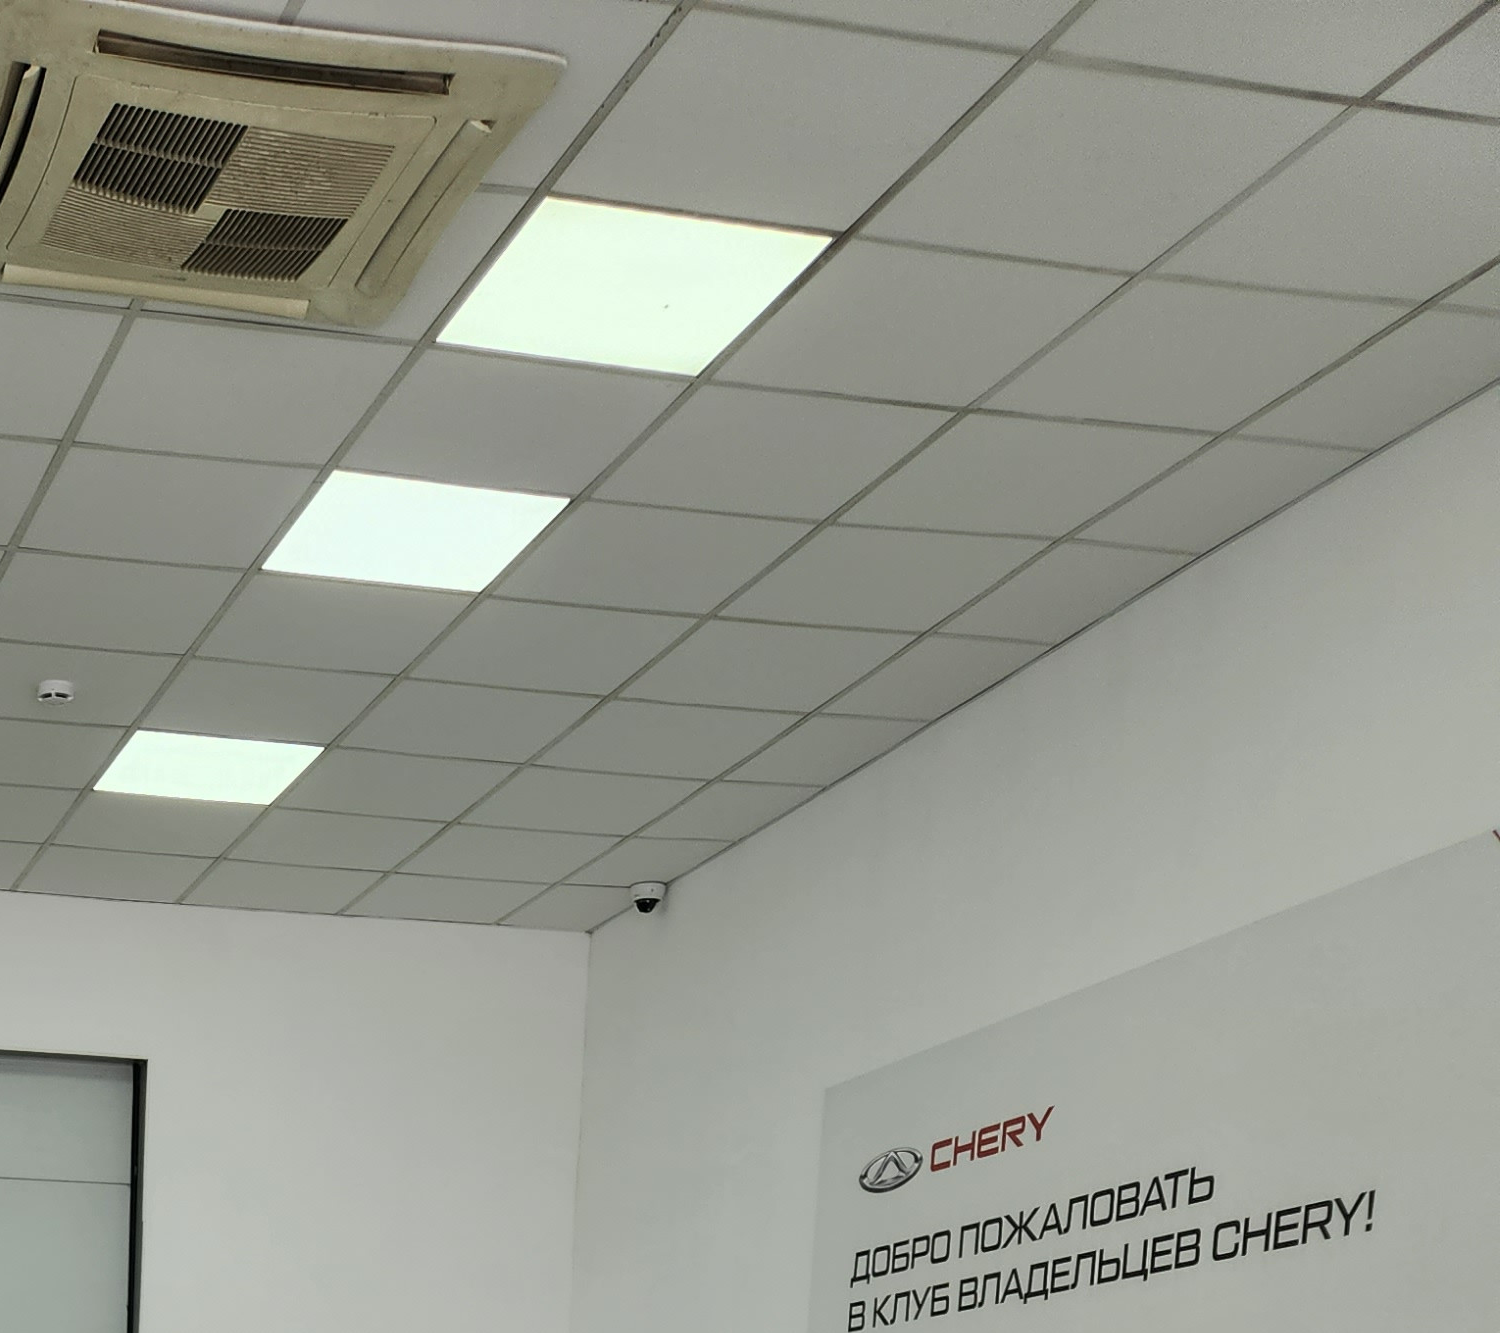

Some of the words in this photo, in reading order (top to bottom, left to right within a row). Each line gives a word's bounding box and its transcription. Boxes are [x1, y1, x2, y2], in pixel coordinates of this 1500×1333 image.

[929, 1105, 1054, 1173] CHERY
[847, 1300, 867, 1333] В
[872, 1281, 951, 1329] КЛУБ
[957, 1227, 1202, 1313] ВЛАДЕЛЬЦЕВ
[1211, 1189, 1377, 1262] CHERY!
[849, 1229, 952, 1289] ДОБРО
[958, 1166, 1216, 1259] ПОЖАЛОВАТЬ
